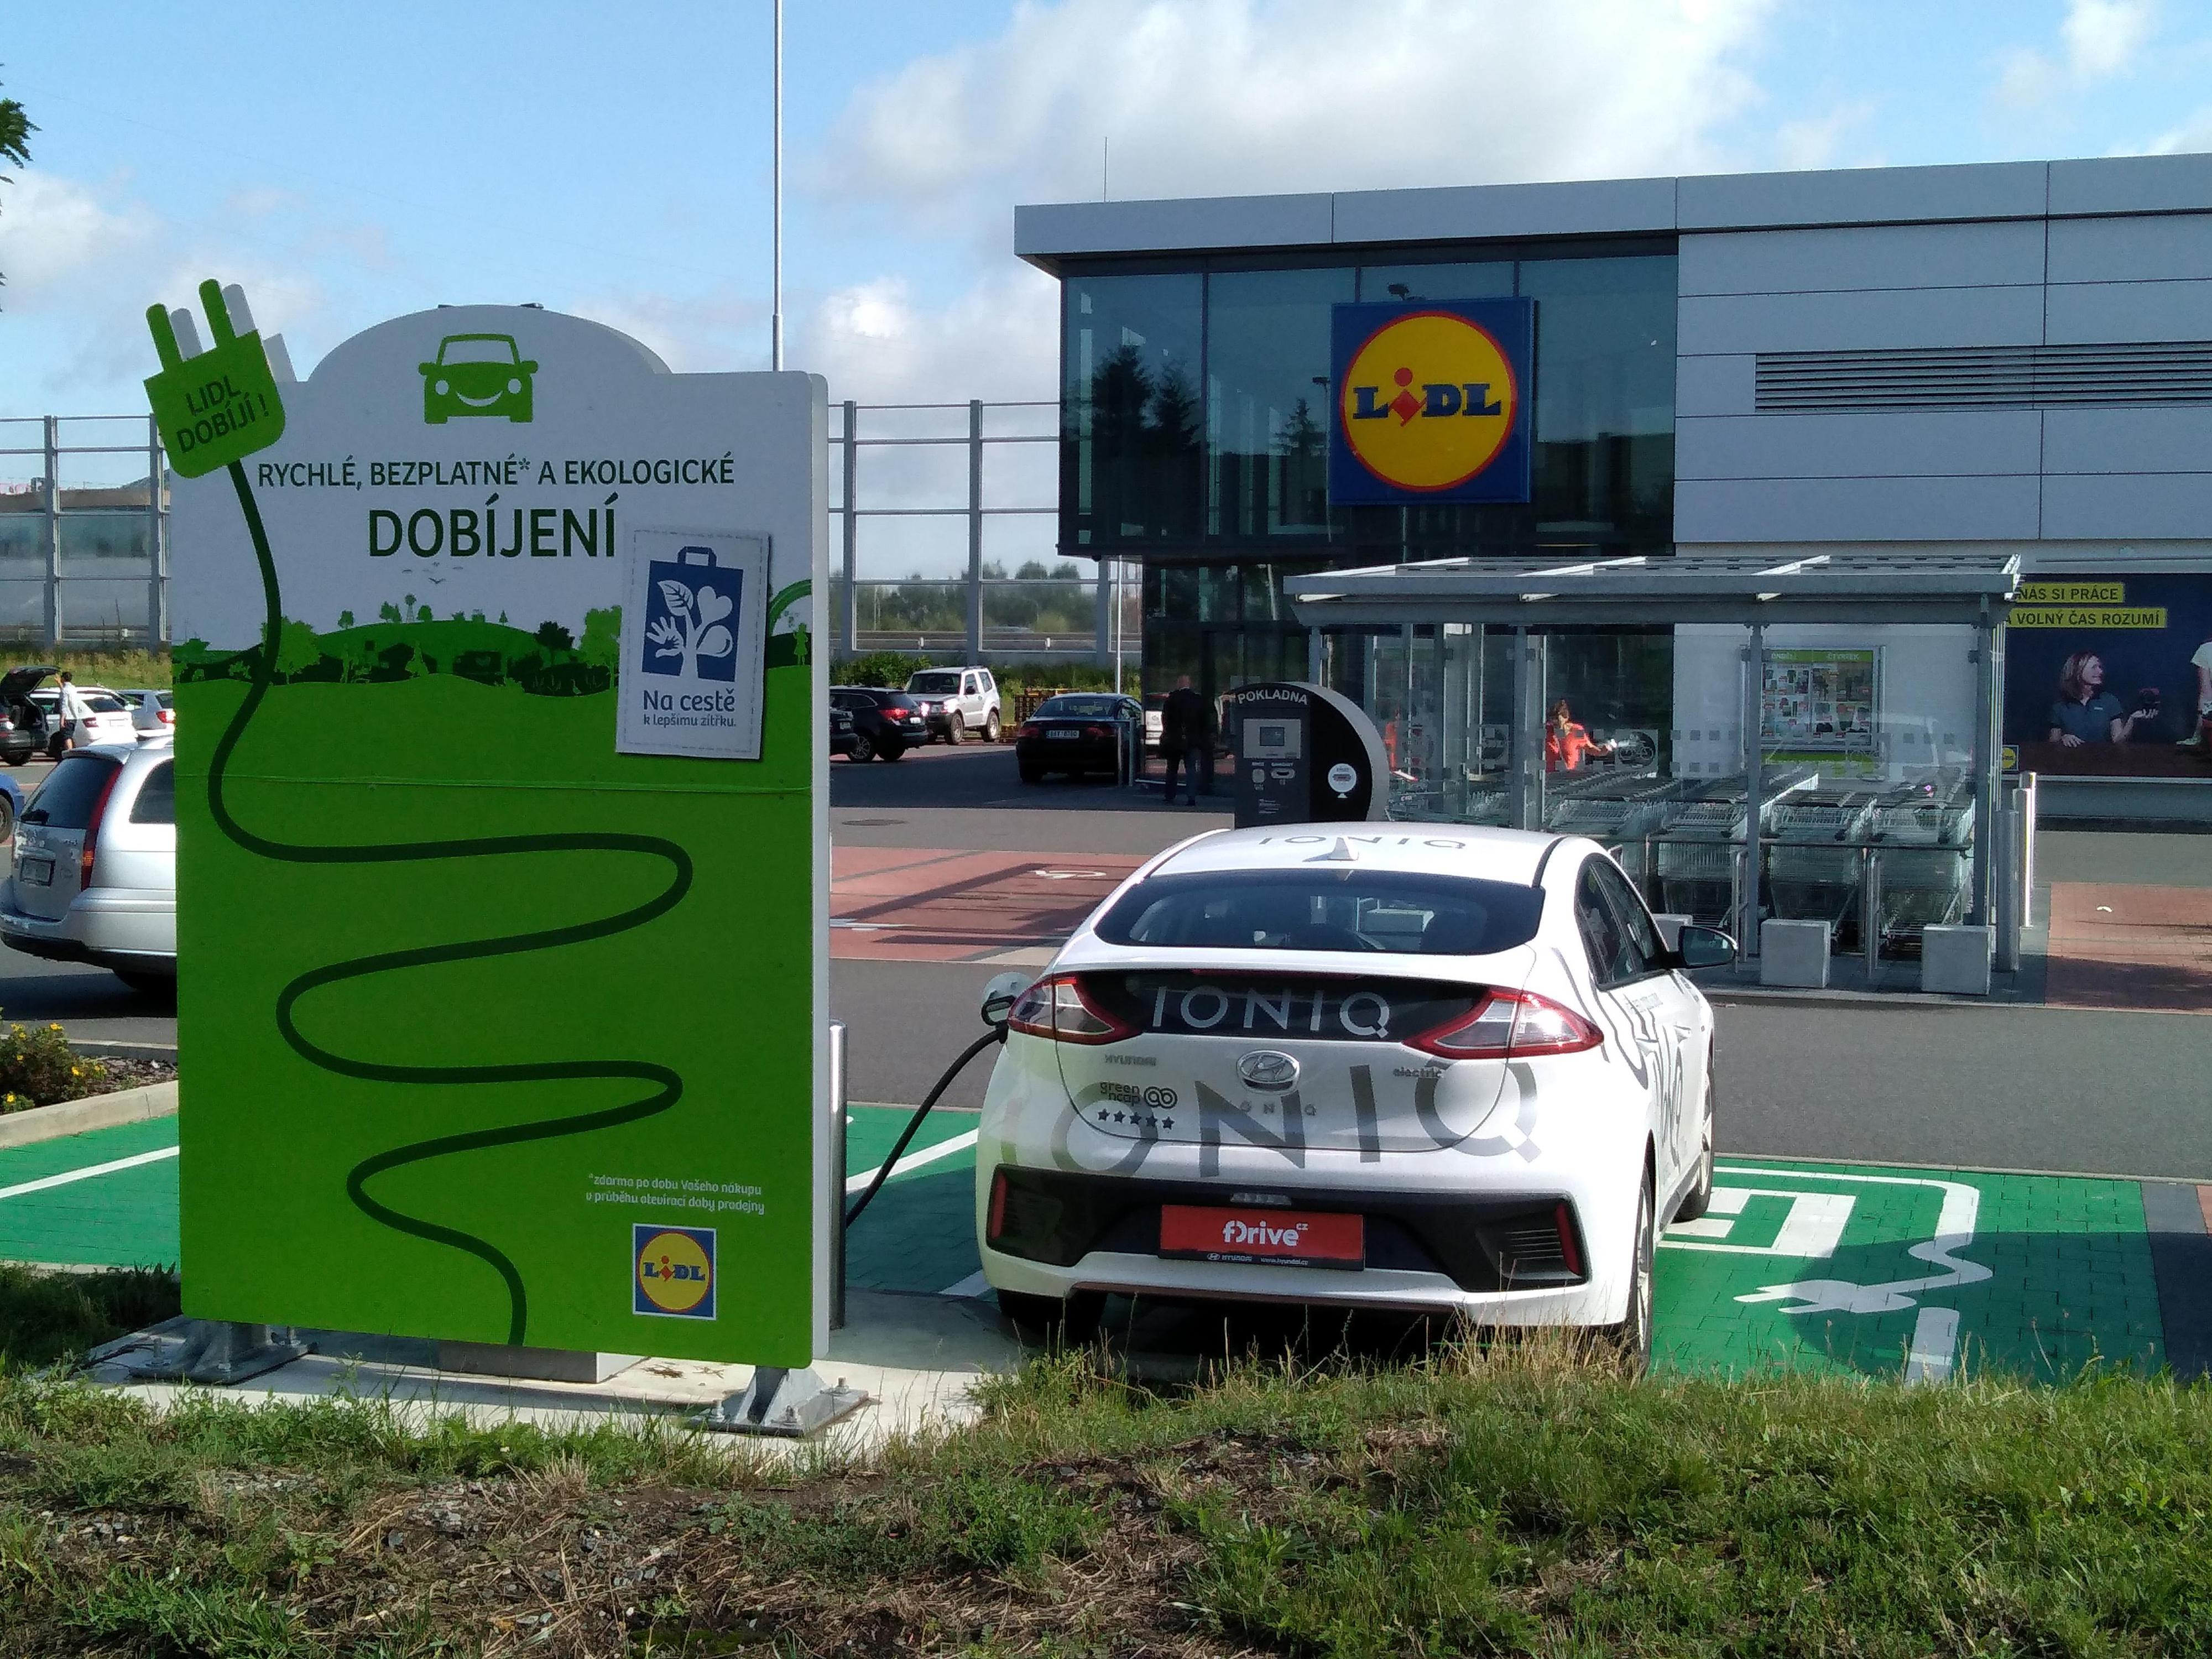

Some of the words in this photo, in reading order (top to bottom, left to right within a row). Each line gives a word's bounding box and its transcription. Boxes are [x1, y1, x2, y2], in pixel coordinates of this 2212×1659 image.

[185, 375, 242, 417] LIDL
[1353, 367, 1502, 426] LIDL
[258, 455, 362, 491] RYCHLÉ,
[537, 460, 557, 485] A
[565, 451, 734, 484] EKOLOGICKÉ
[369, 491, 619, 558] DOBÍJENÍ
[2018, 585, 2047, 600] NÁS
[2052, 588, 2065, 601] SI
[2070, 584, 2119, 601] PRÁCE
[2017, 609, 2064, 625] VOLNÝ
[2068, 609, 2099, 625] ČAS
[2102, 609, 2159, 625] ROZUMÍ
[643, 690, 673, 711] Na
[680, 687, 735, 712] cestě
[1238, 689, 1308, 705] POKLADNA
[643, 713, 651, 725] k
[653, 713, 698, 728] lepšímu
[1151, 986, 1390, 1039] IONIQ
[1100, 1082, 1140, 1094] green
[1108, 1092, 1140, 1107] ncap
[637, 1178, 649, 1190] po
[651, 1178, 678, 1190] dobu
[681, 1178, 719, 1193] Vašeho
[586, 1192, 593, 1201] v
[594, 1190, 638, 1203] průběhu
[688, 1196, 716, 1212] doby
[718, 1199, 765, 1215] prodejny
[643, 1255, 706, 1281] LIDL
